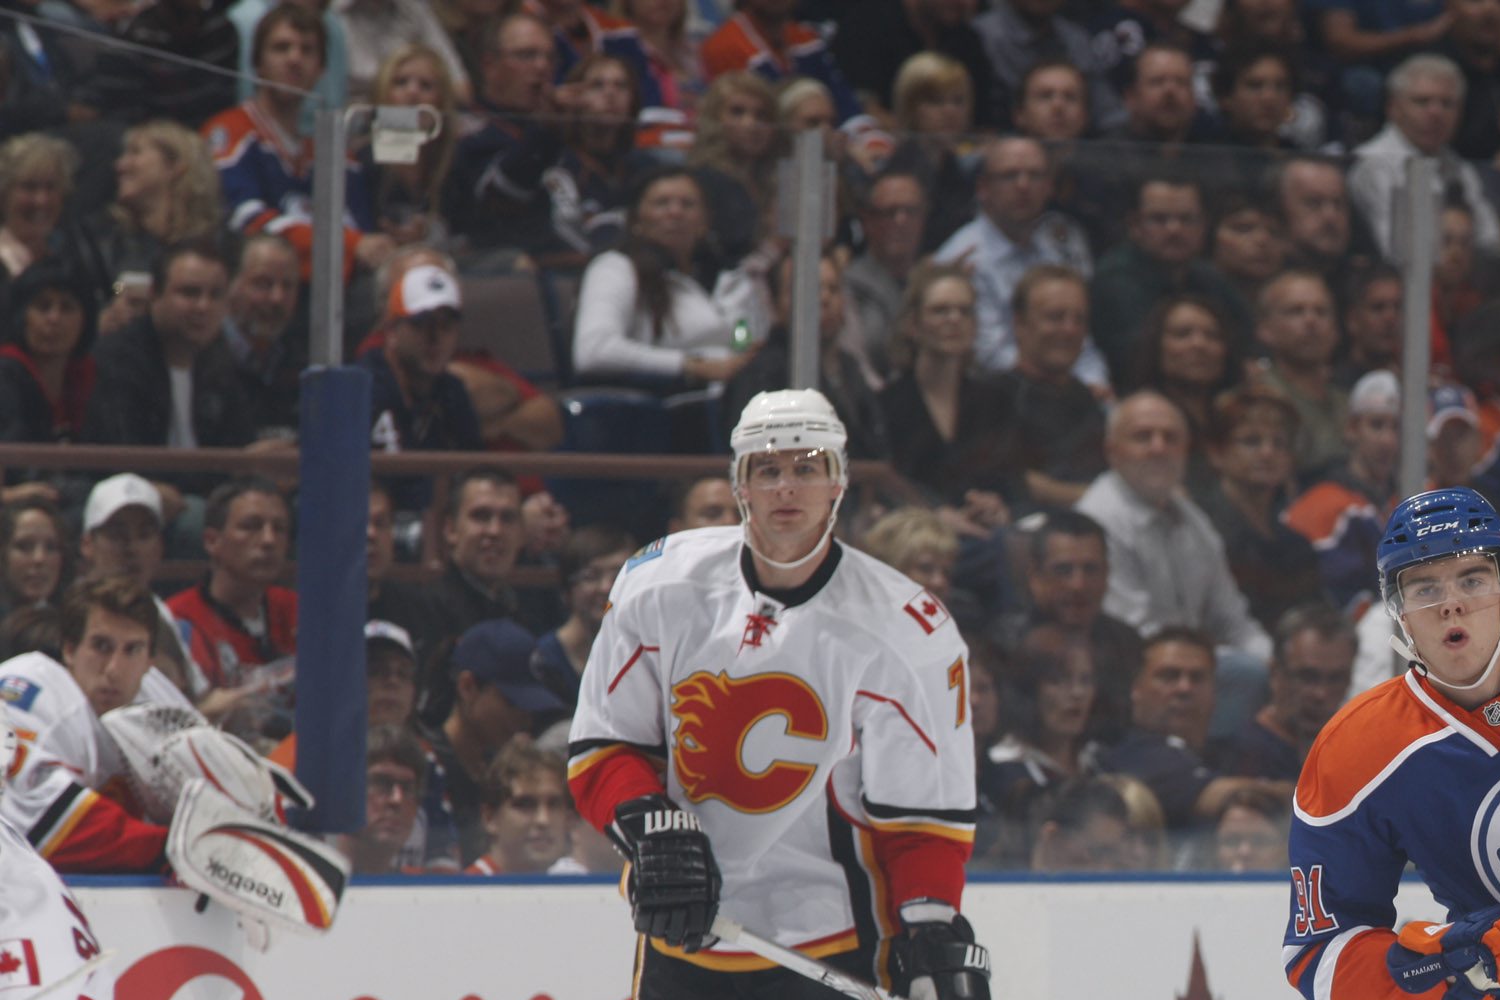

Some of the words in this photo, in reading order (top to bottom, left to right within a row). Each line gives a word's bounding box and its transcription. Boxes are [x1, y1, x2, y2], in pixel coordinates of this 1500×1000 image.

[1416, 521, 1460, 537] CCM
[206, 856, 285, 909] Reebok
[1290, 864, 1340, 937] 91
